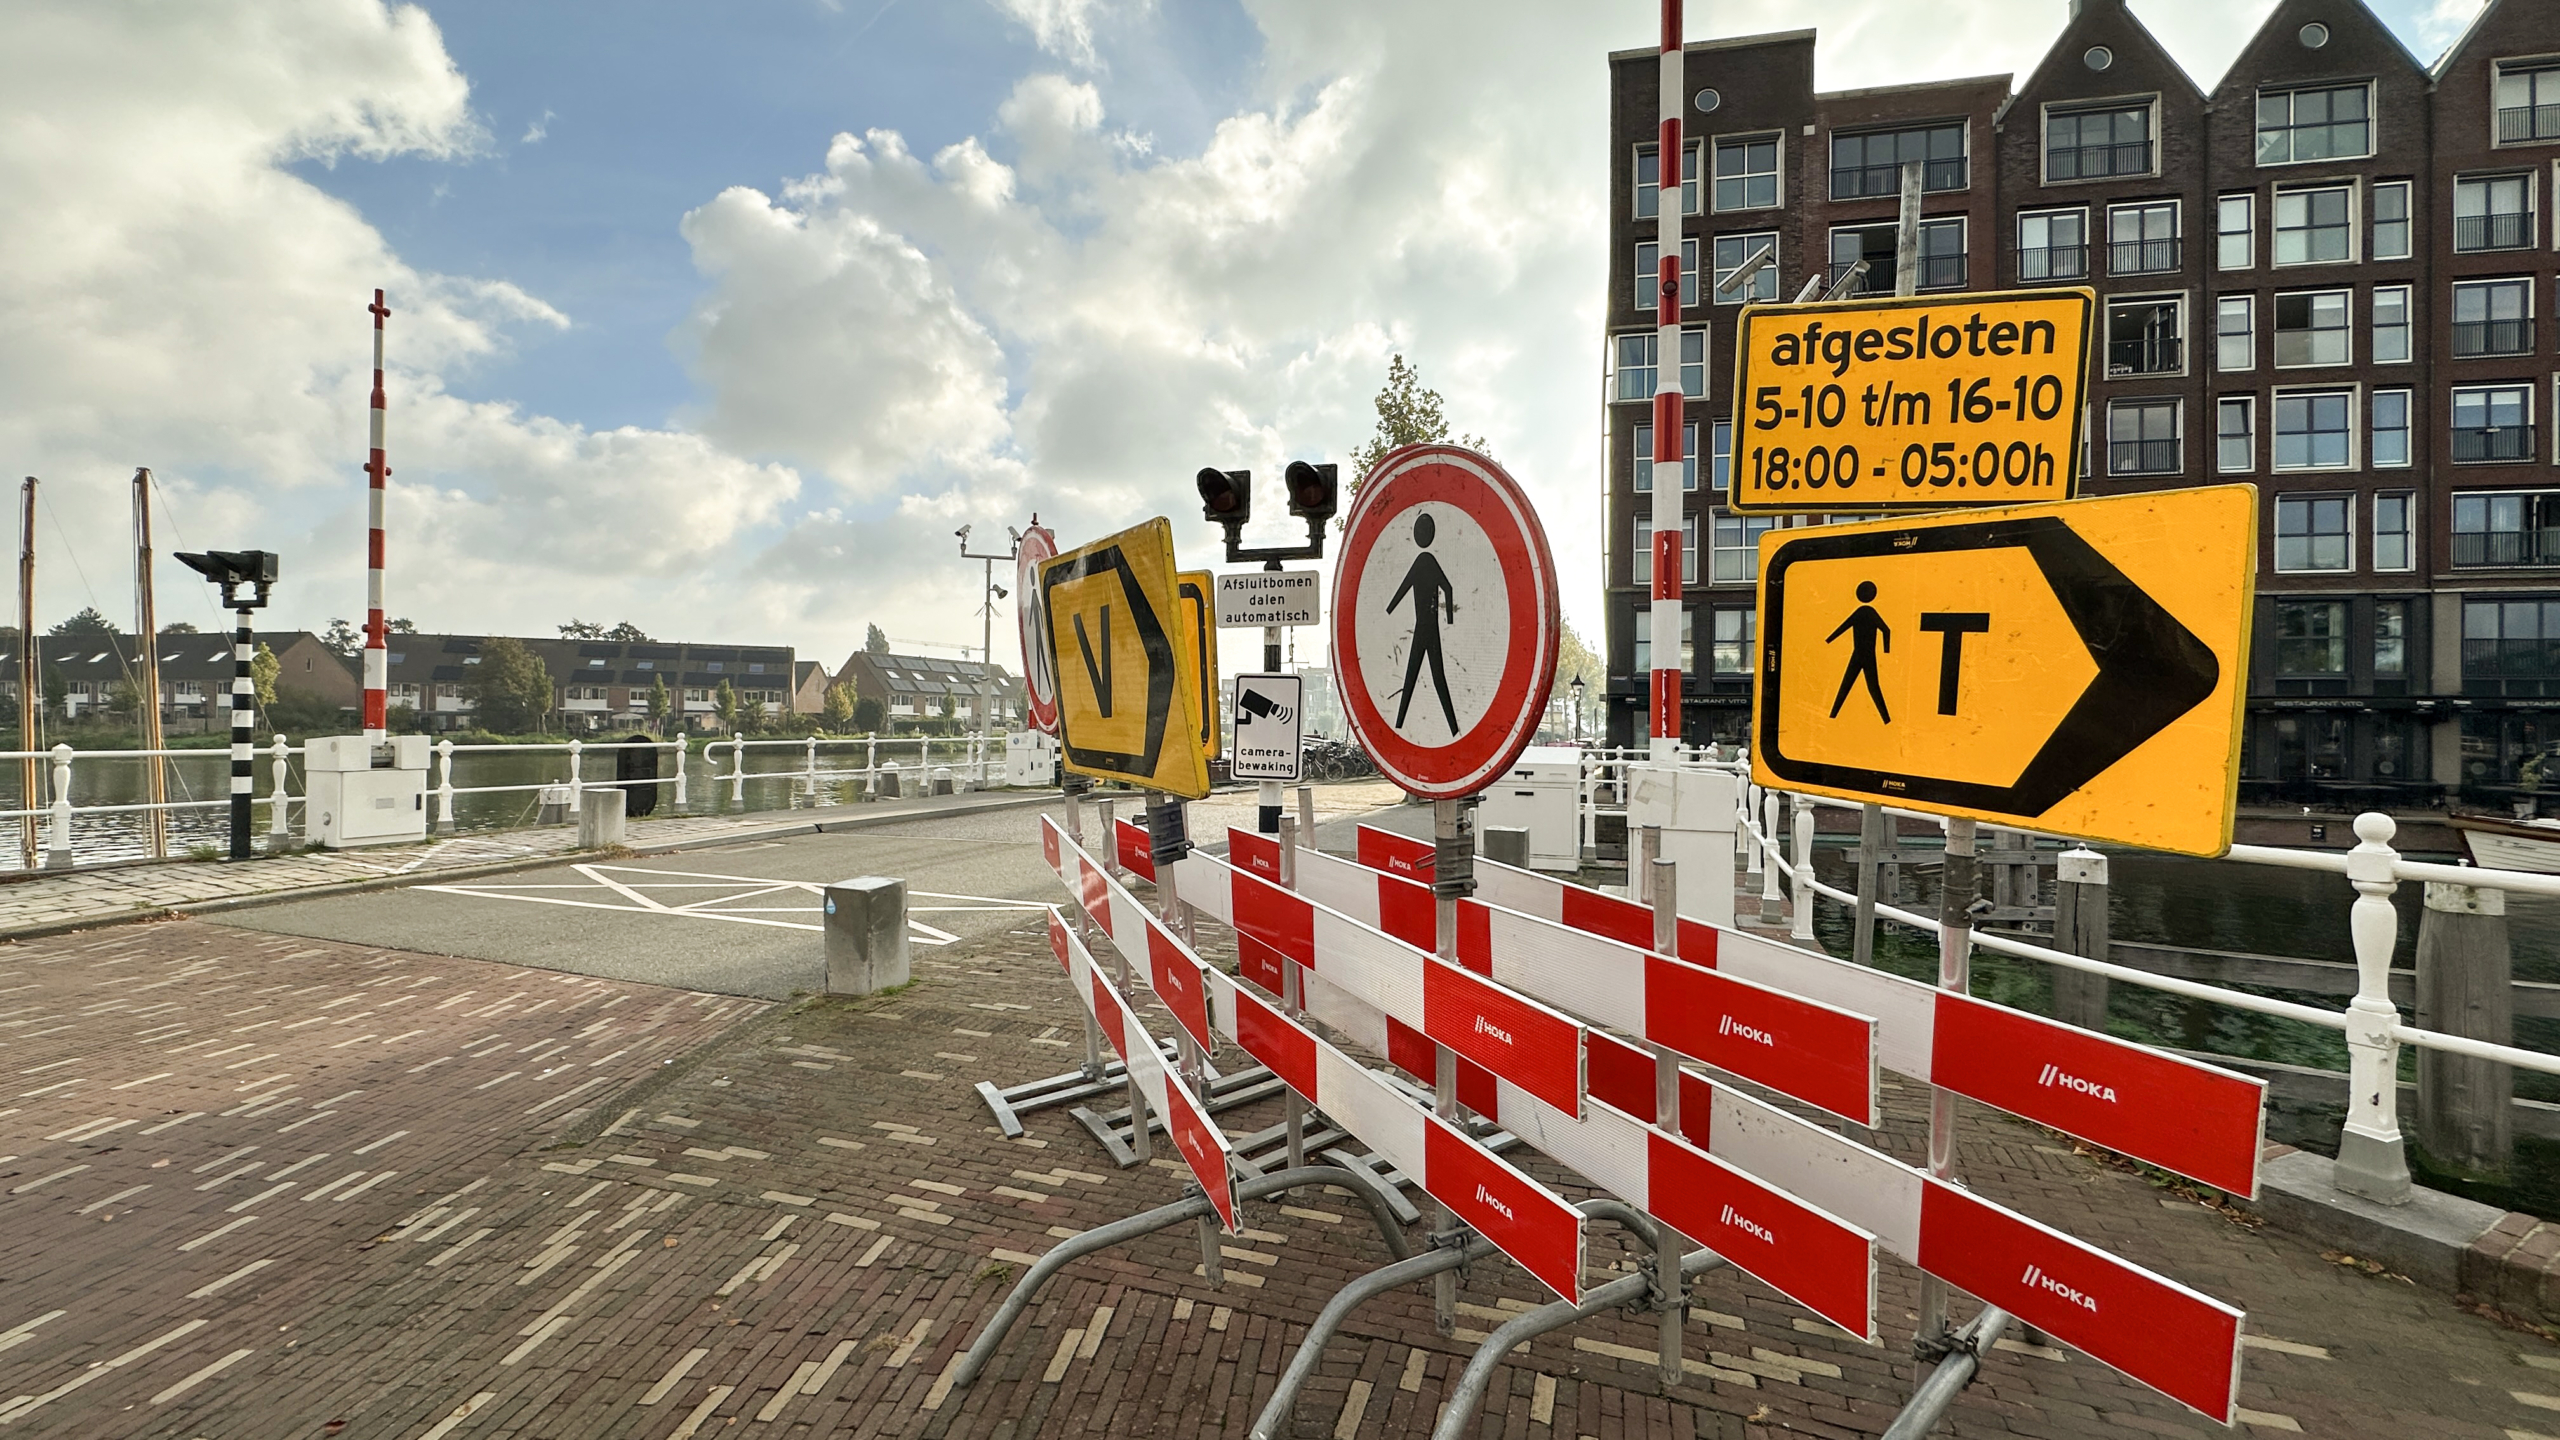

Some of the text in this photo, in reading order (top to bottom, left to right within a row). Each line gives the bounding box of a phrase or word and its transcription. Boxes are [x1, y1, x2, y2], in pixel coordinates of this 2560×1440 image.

[1771, 312, 2056, 379] afgesloten
[1754, 374, 2063, 431] 5-10 t/m 16-10
[1752, 445, 1859, 491] 18:00
[1900, 441, 2055, 488] 05:00h
[1223, 577, 1312, 590] Afsluitbomen
[1226, 609, 1309, 623] automatisch
[1249, 594, 1285, 606] dalen
[1073, 604, 1111, 718] V
[1919, 612, 1991, 717] T
[1238, 760, 1293, 774] bewaking
[1240, 748, 1291, 757] camera-
